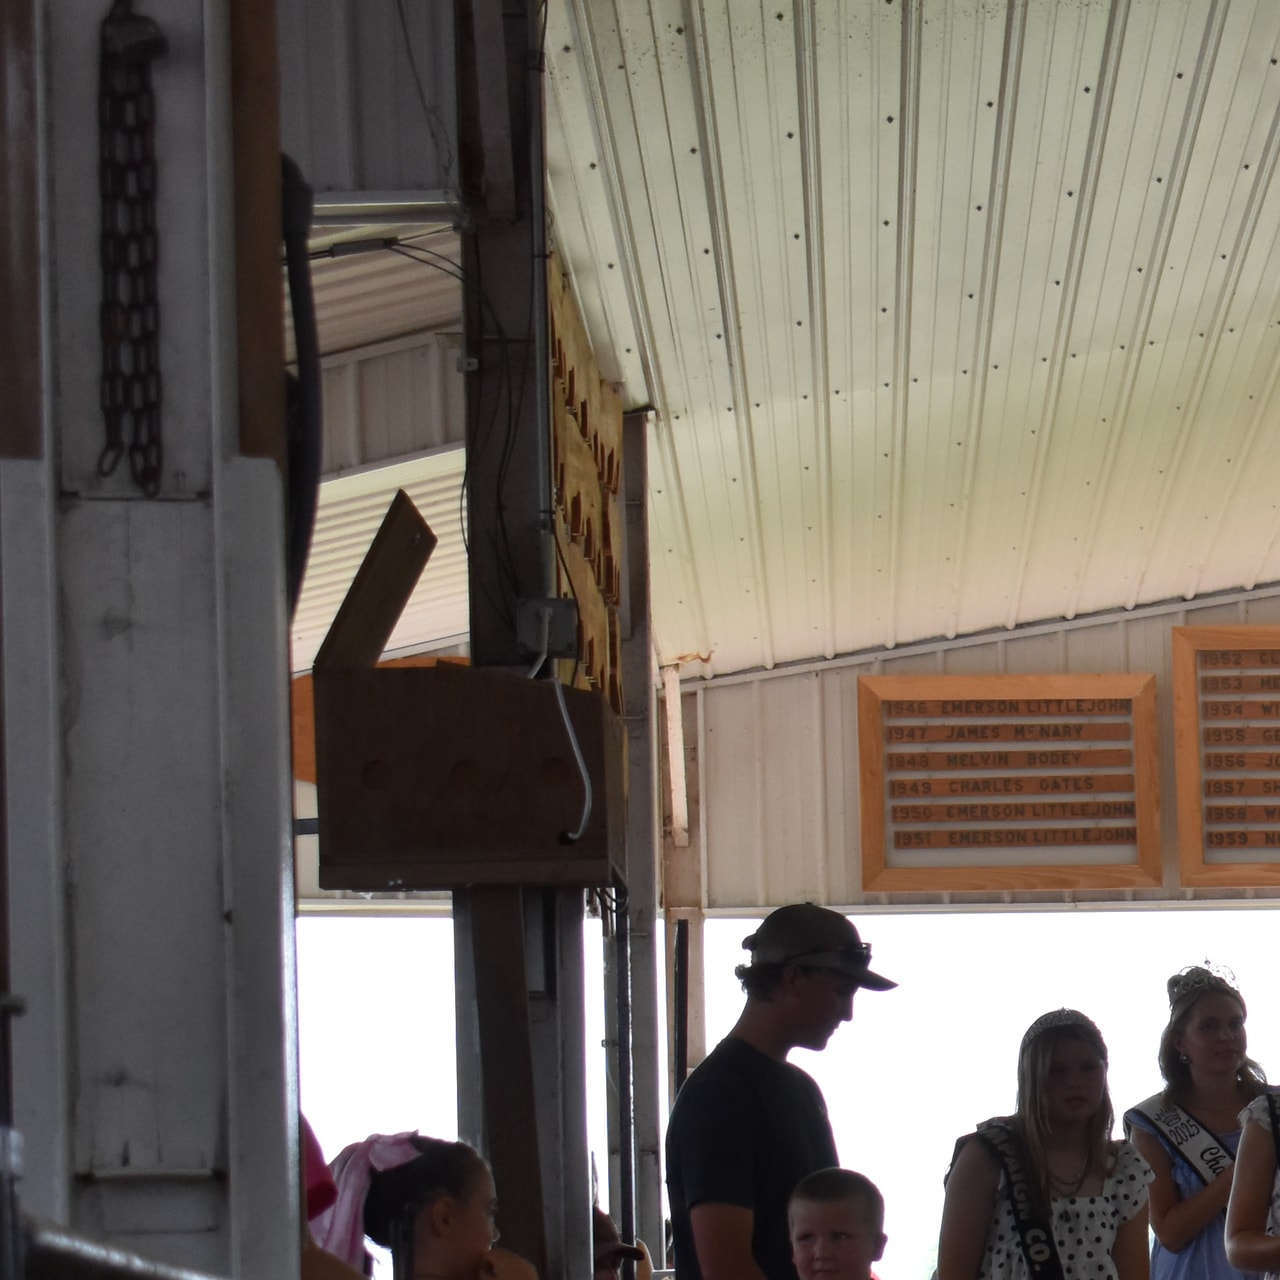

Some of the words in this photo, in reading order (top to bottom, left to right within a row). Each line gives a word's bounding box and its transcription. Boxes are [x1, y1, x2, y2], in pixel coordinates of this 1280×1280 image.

[1205, 704, 1244, 717] 1954
[888, 756, 930, 768] 1948
[947, 754, 1009, 767] MELVIN
[1027, 752, 1082, 765] BODEY
[1206, 754, 1247, 768] 1956
[891, 781, 933, 794] 1949
[948, 779, 1024, 793] CHARLES
[1207, 781, 1245, 794] 1957
[895, 831, 932, 847] 1951
[948, 830, 1028, 845] EMERSON
[1209, 832, 1248, 846] 1959
[1168, 1119, 1201, 1146] 2025
[1200, 1146, 1227, 1177] Cha
[1023, 1228, 1052, 1272] CO.
